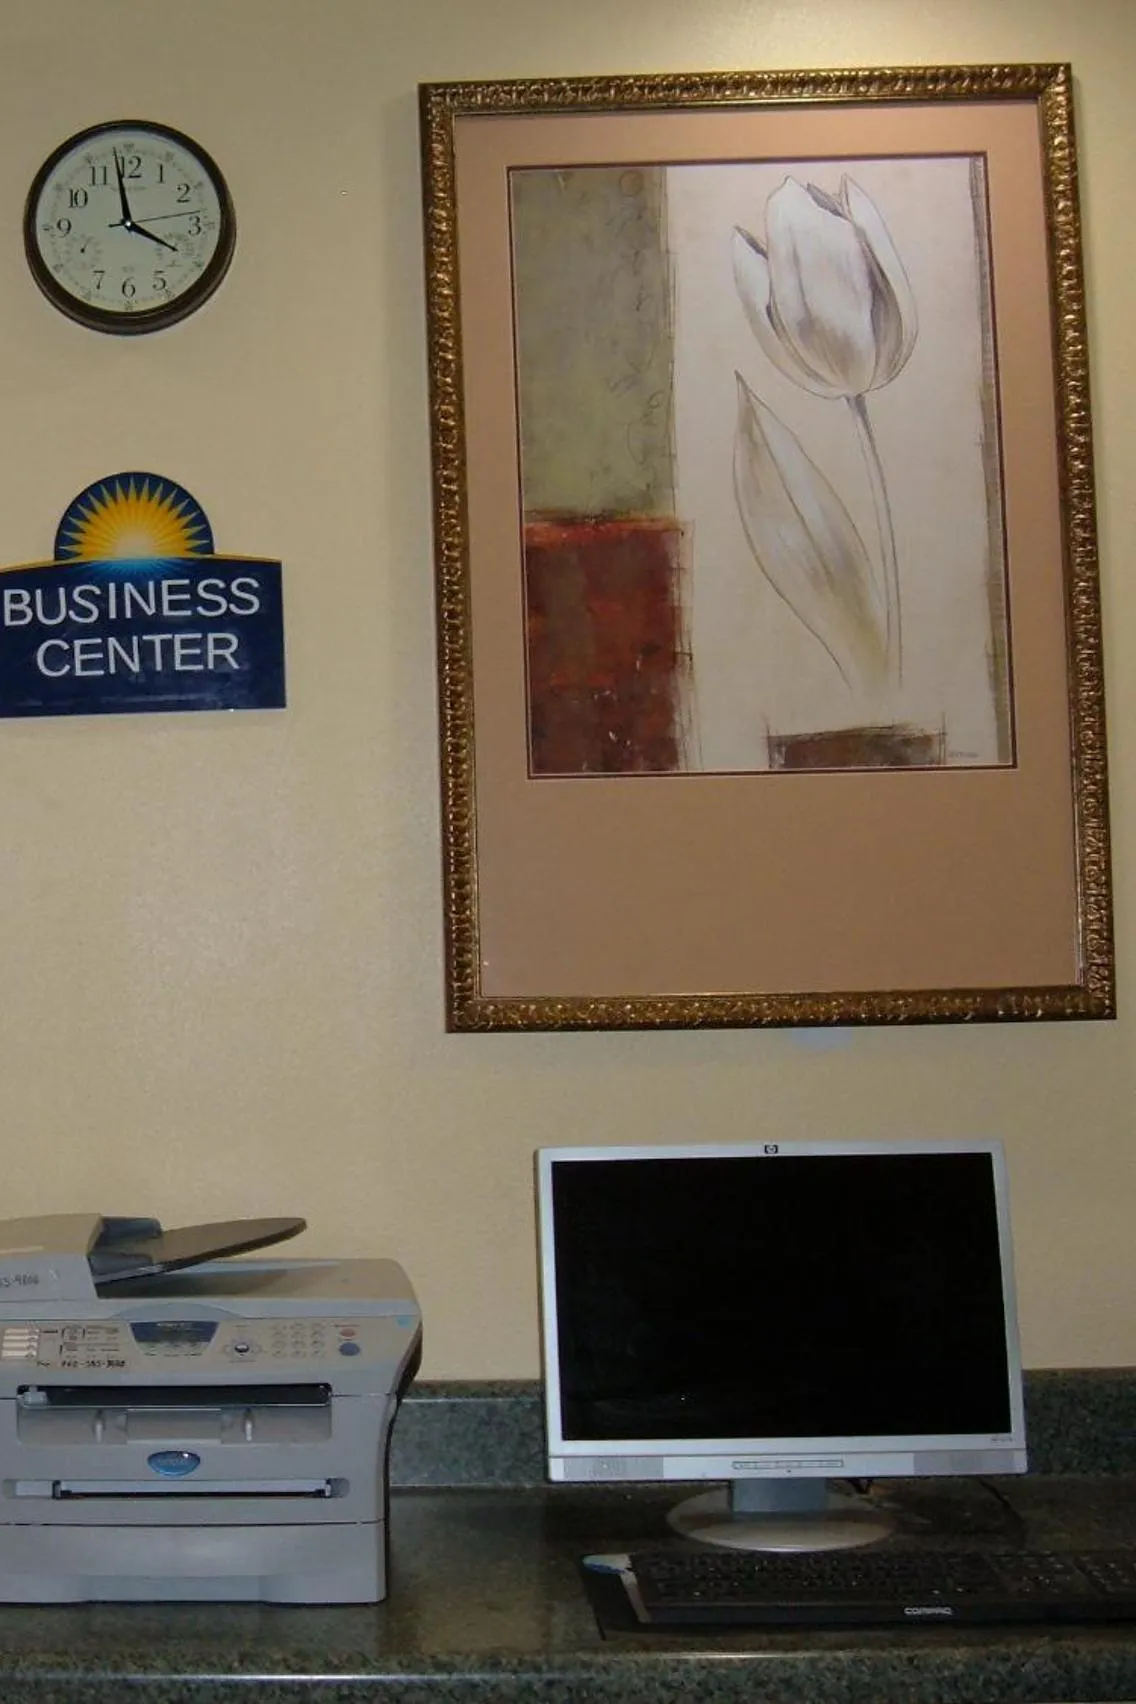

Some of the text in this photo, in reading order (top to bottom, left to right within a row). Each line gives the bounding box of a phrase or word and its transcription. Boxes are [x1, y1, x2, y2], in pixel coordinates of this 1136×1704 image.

[88, 165, 109, 186] 11
[118, 155, 142, 179] 12
[156, 163, 165, 184] 1
[67, 188, 89, 208] 10
[175, 183, 191, 203] 2
[56, 217, 72, 238] 9
[187, 215, 202, 236] 3
[92, 269, 106, 290] 7
[121, 278, 136, 298] 6
[151, 270, 167, 290] 5
[2, 577, 262, 627] BUSINESS
[35, 632, 241, 678] CENTER
